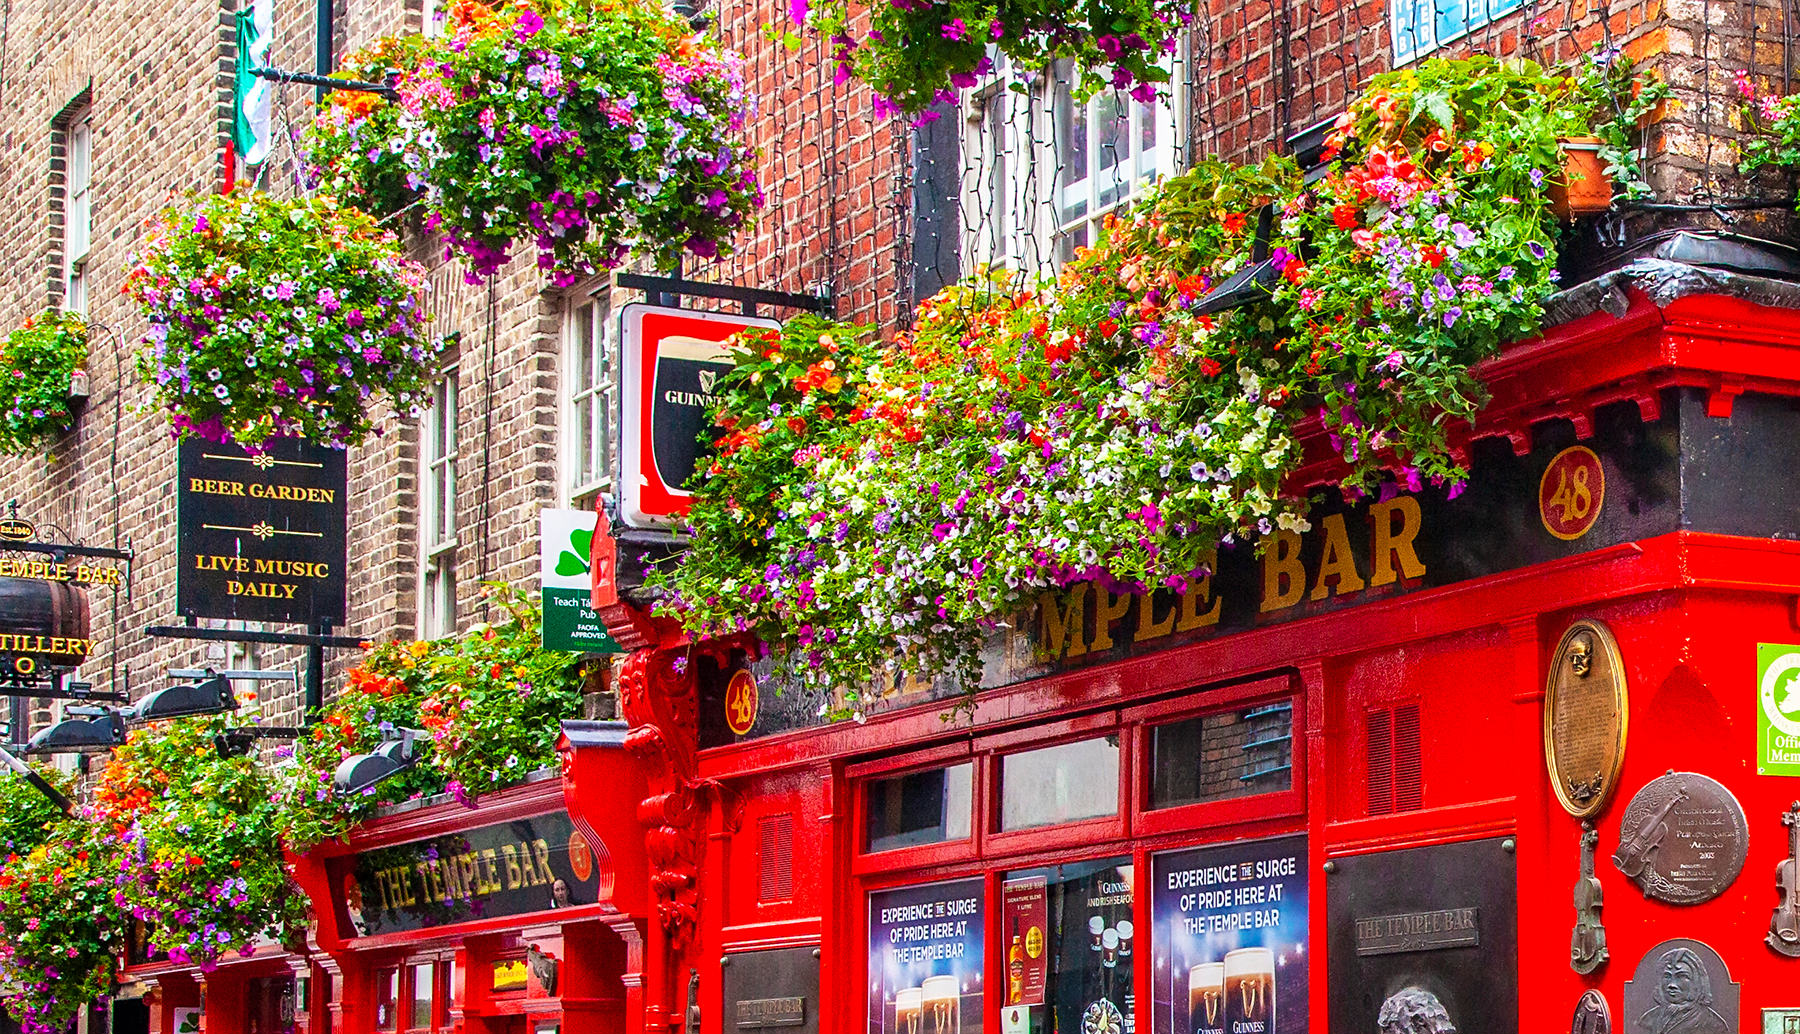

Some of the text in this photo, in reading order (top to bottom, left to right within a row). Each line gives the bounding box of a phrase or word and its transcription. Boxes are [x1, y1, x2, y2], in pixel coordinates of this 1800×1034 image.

[190, 478, 335, 503] BEER GARDEN
[1549, 464, 1590, 524] 48
[196, 554, 330, 578] LIVE MUSIC
[1259, 495, 1427, 614] BAR
[0, 560, 120, 585] EMPLE BAR
[227, 580, 298, 599] DAILY
[554, 597, 578, 607] Teach
[580, 610, 596, 619] Pub
[0, 633, 98, 656] TILLERY
[731, 682, 751, 725] 48
[374, 866, 416, 910] THE
[417, 848, 502, 903] TEMPLE
[502, 838, 555, 891] BAR
[1168, 857, 1296, 890] EXPERIENCE THE SURGE
[1103, 882, 1130, 894] GUINNESS
[1180, 884, 1283, 912] OF PRIDE HERE AT
[881, 898, 977, 924] EXPERIENCE SURGE
[1087, 898, 1099, 907] AND
[890, 920, 967, 943] OF PRIDE HERE AT
[1184, 909, 1279, 934] THE TEMPLE BAR
[1356, 910, 1474, 940] THE TEMPLE BAR
[893, 943, 964, 963] THE TEMPLE BAR
[1233, 1020, 1265, 1034] GUINNESS
